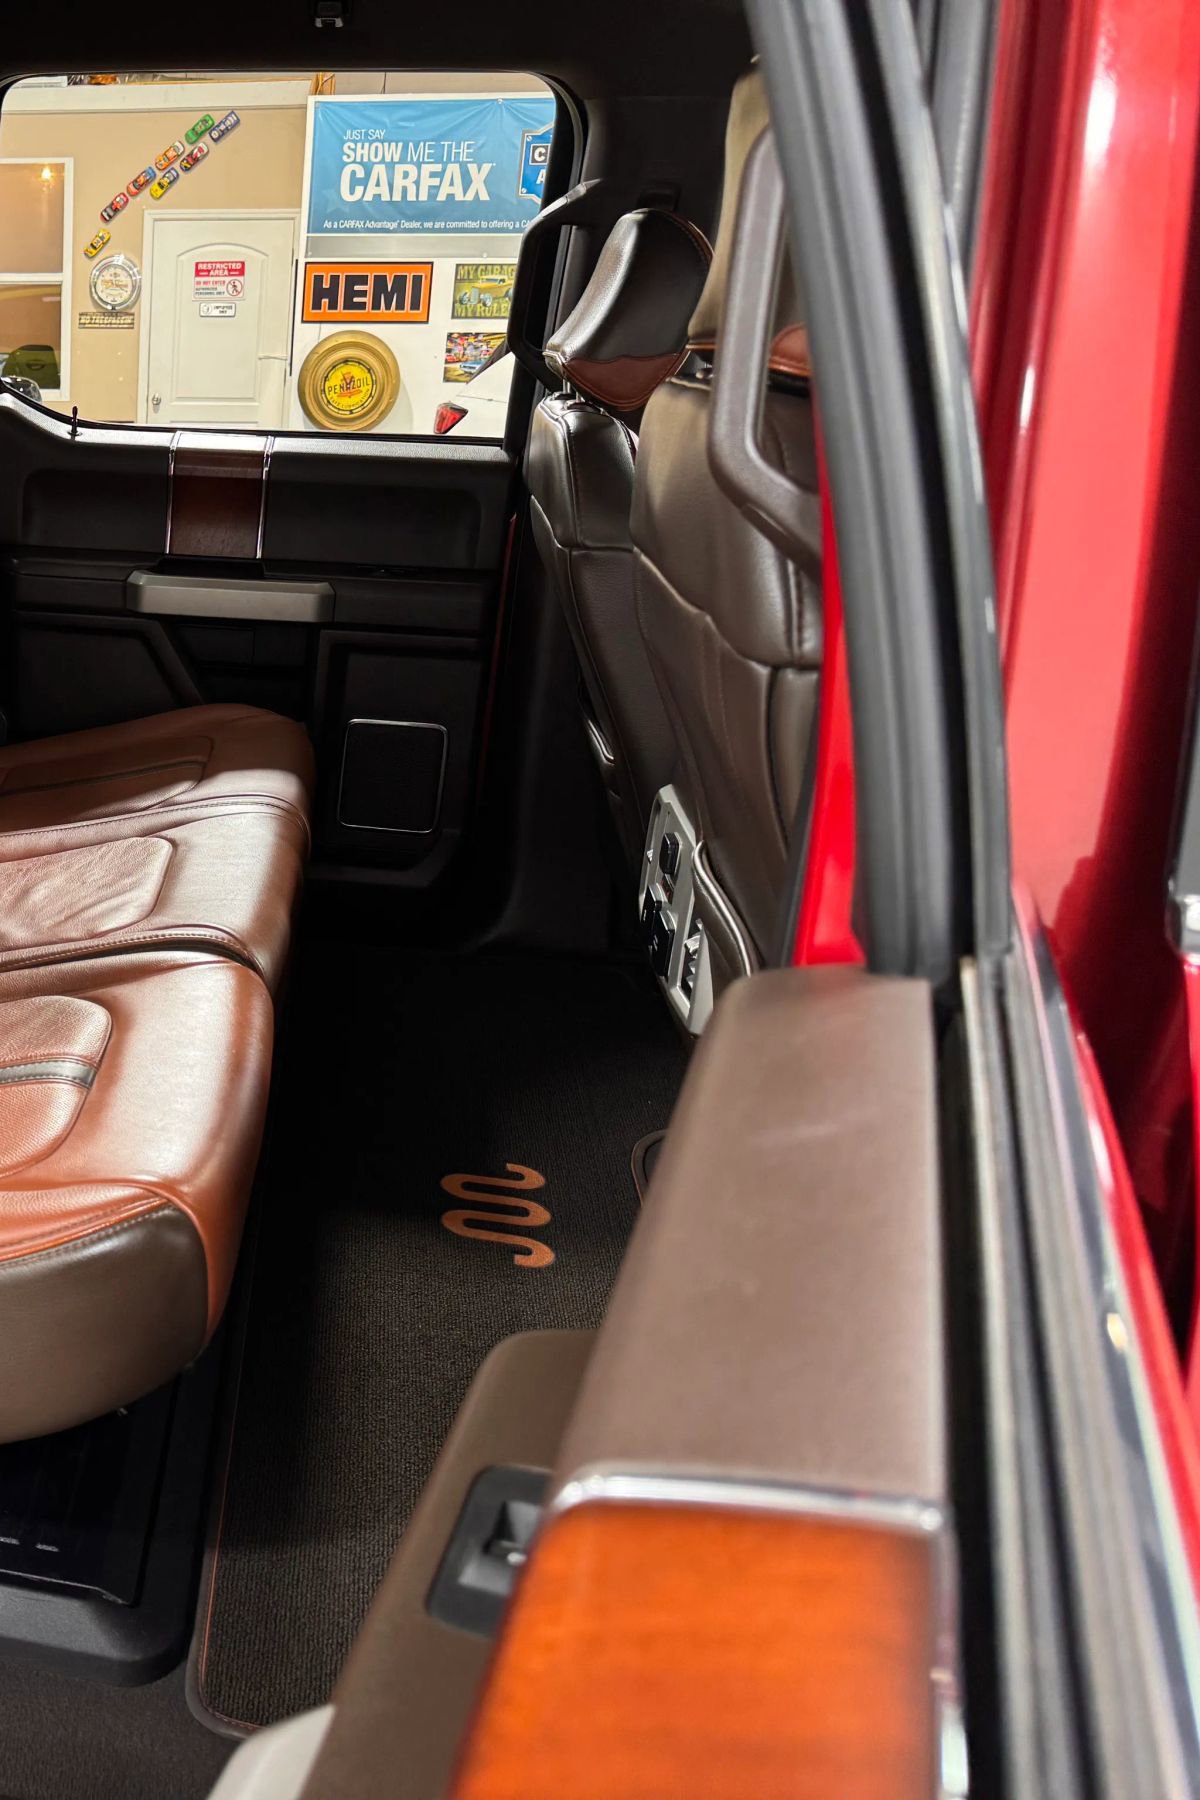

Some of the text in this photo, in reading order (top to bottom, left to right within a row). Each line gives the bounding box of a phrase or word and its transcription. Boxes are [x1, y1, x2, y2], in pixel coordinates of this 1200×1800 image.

[343, 128, 386, 140] JUST SAY
[342, 141, 476, 163] SHOW ME THE
[340, 163, 493, 201] CARFAX
[323, 220, 333, 229] As
[333, 221, 338, 229] a
[339, 220, 364, 229] CARFAX
[401, 220, 422, 229] Dealer,
[423, 221, 434, 229] we
[434, 221, 445, 229] are
[446, 219, 480, 229] committed
[481, 220, 488, 229] to
[488, 219, 513, 230] offering
[198, 262, 242, 270] RESTRICTED
[457, 265, 517, 280] MY GARAG
[310, 272, 425, 313] HEMI
[455, 303, 510, 317] MY RULE
